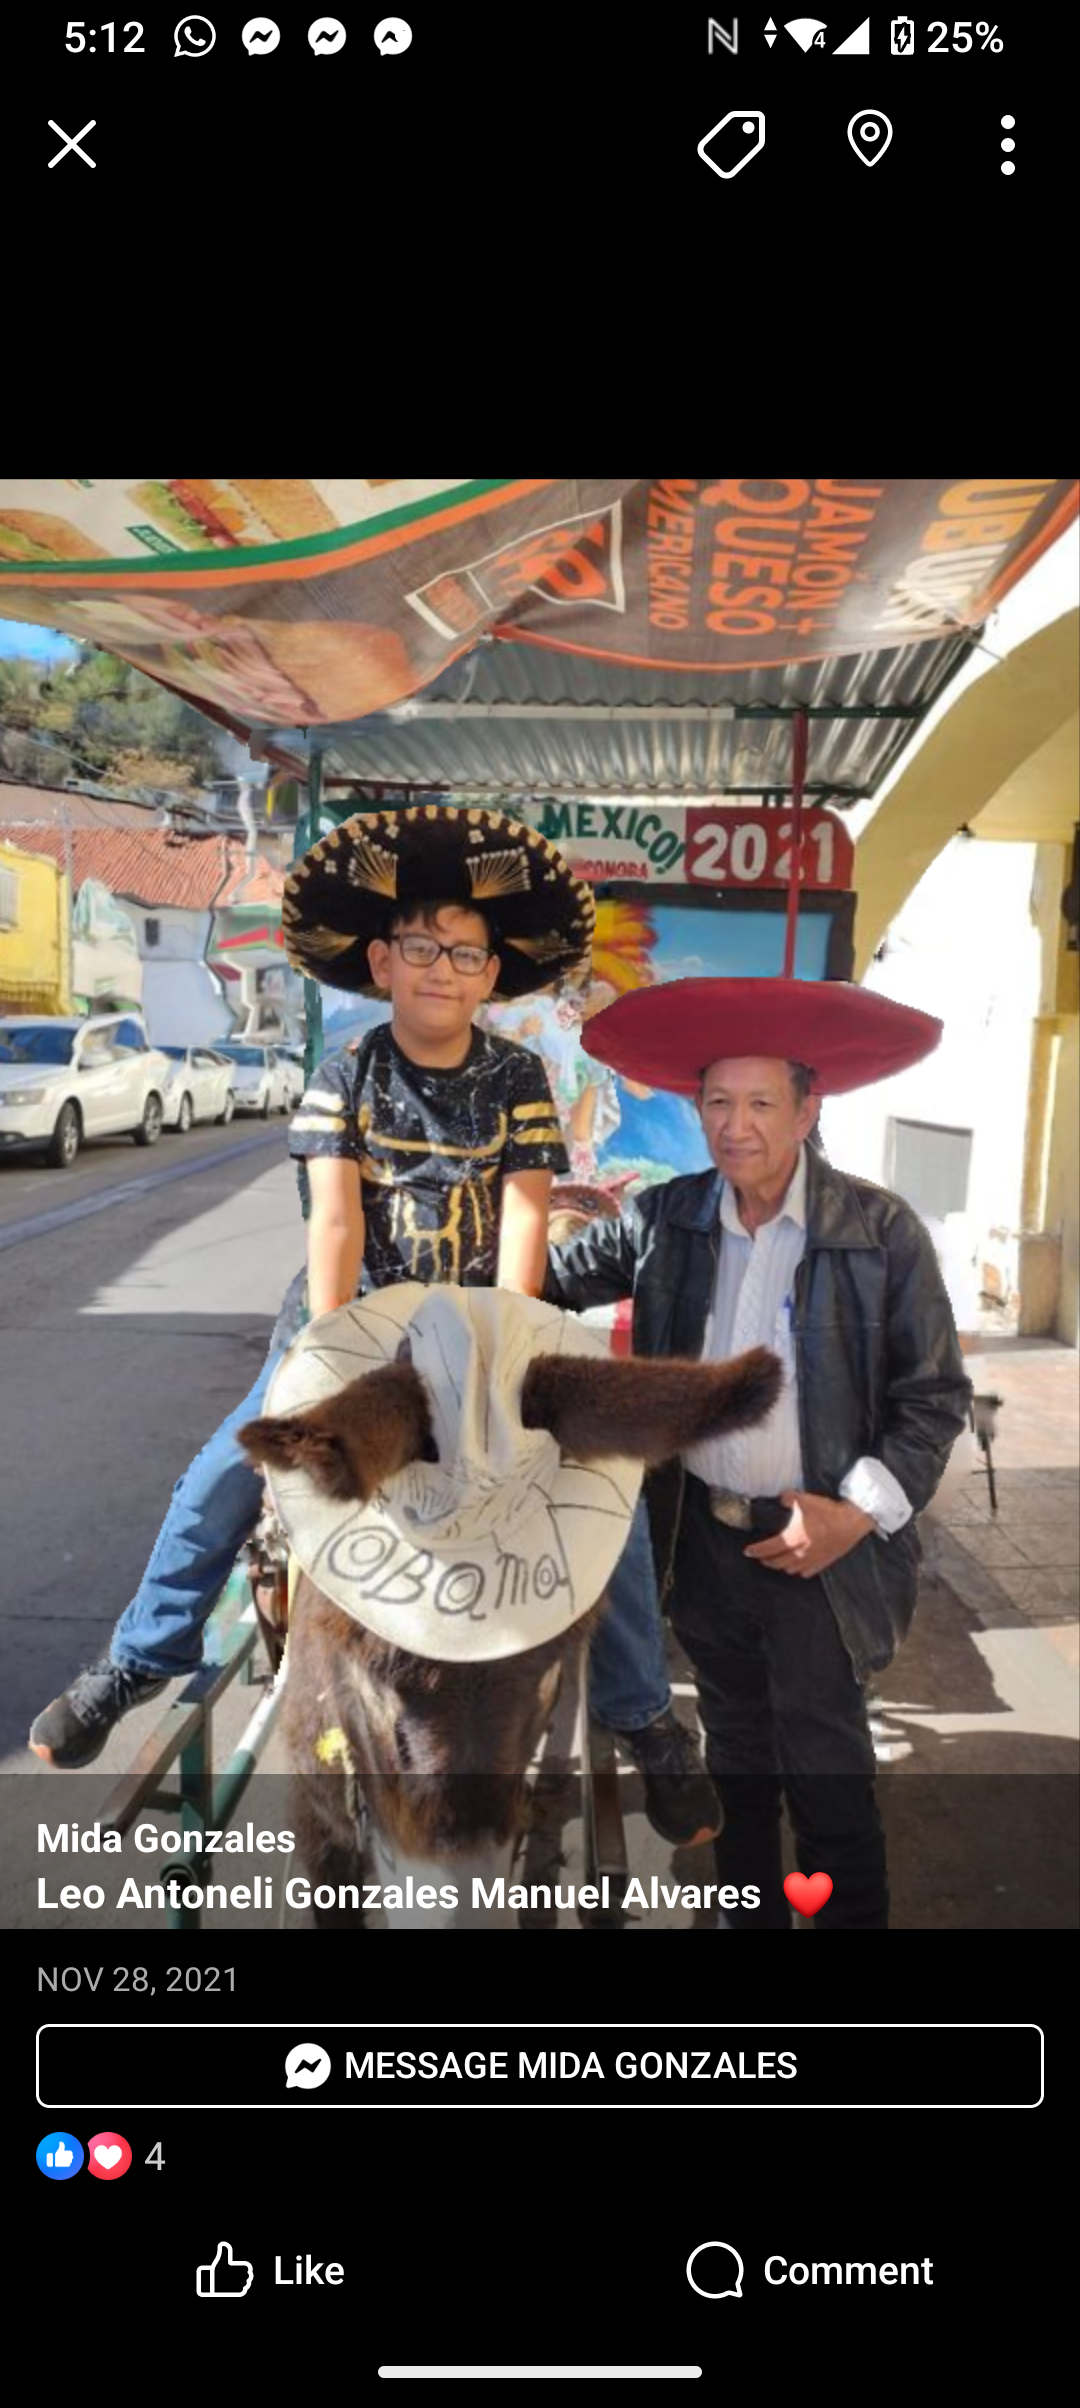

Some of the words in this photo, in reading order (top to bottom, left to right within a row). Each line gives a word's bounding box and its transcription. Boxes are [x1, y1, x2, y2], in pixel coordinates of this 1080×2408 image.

[647, 479, 697, 631] MERICANO
[702, 479, 810, 637] QUESO
[691, 820, 833, 884] 2021
